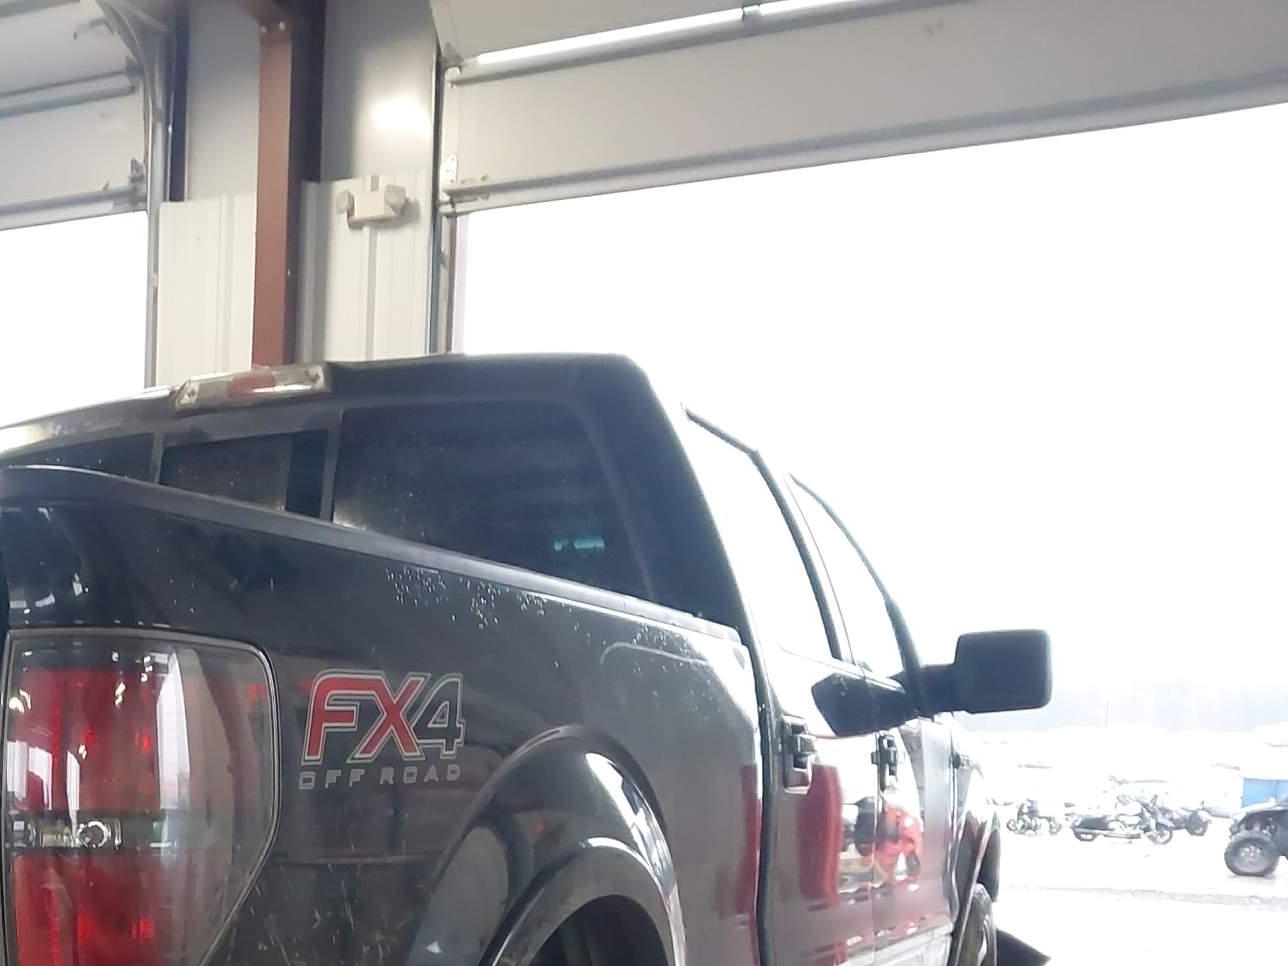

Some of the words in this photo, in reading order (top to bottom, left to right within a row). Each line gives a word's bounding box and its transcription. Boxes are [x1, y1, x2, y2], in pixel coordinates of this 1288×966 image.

[301, 668, 465, 765] FX4
[298, 768, 365, 790] OFF
[379, 763, 461, 785] ROAD
